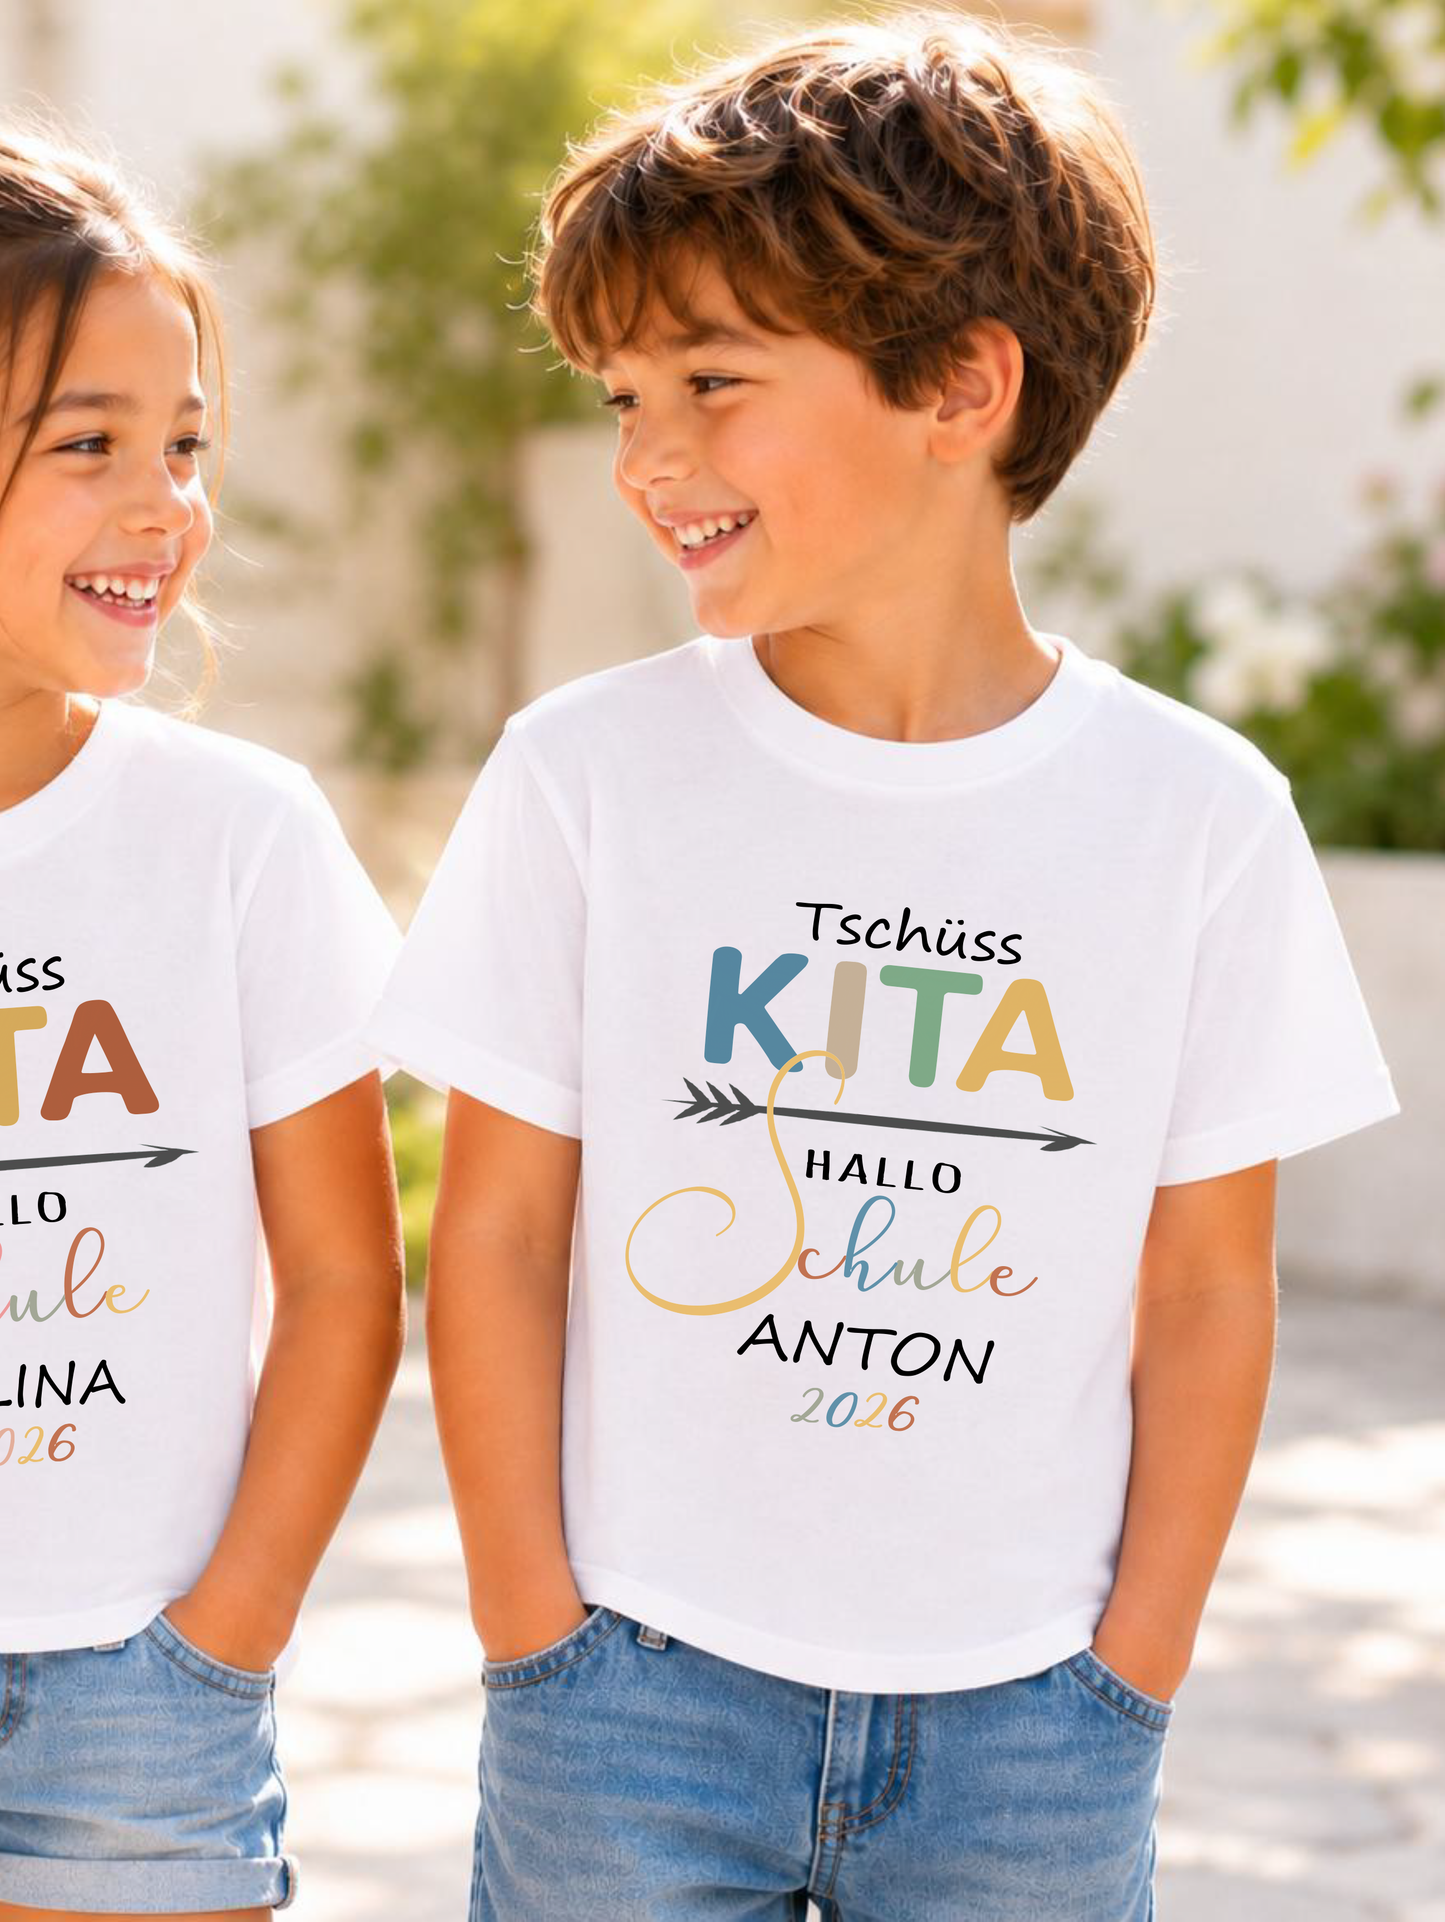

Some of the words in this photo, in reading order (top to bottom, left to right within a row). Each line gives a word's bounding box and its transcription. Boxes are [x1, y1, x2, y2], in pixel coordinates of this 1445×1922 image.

[796, 902, 1022, 965] Tschüss
[704, 946, 1074, 1102] KITA
[625, 1050, 1038, 1316] Schule
[805, 1149, 962, 1194] HALLO
[0, 1191, 67, 1226] LO
[0, 1226, 150, 1322] ule
[737, 1314, 995, 1384] ANTON
[790, 1387, 920, 1432] 2026
